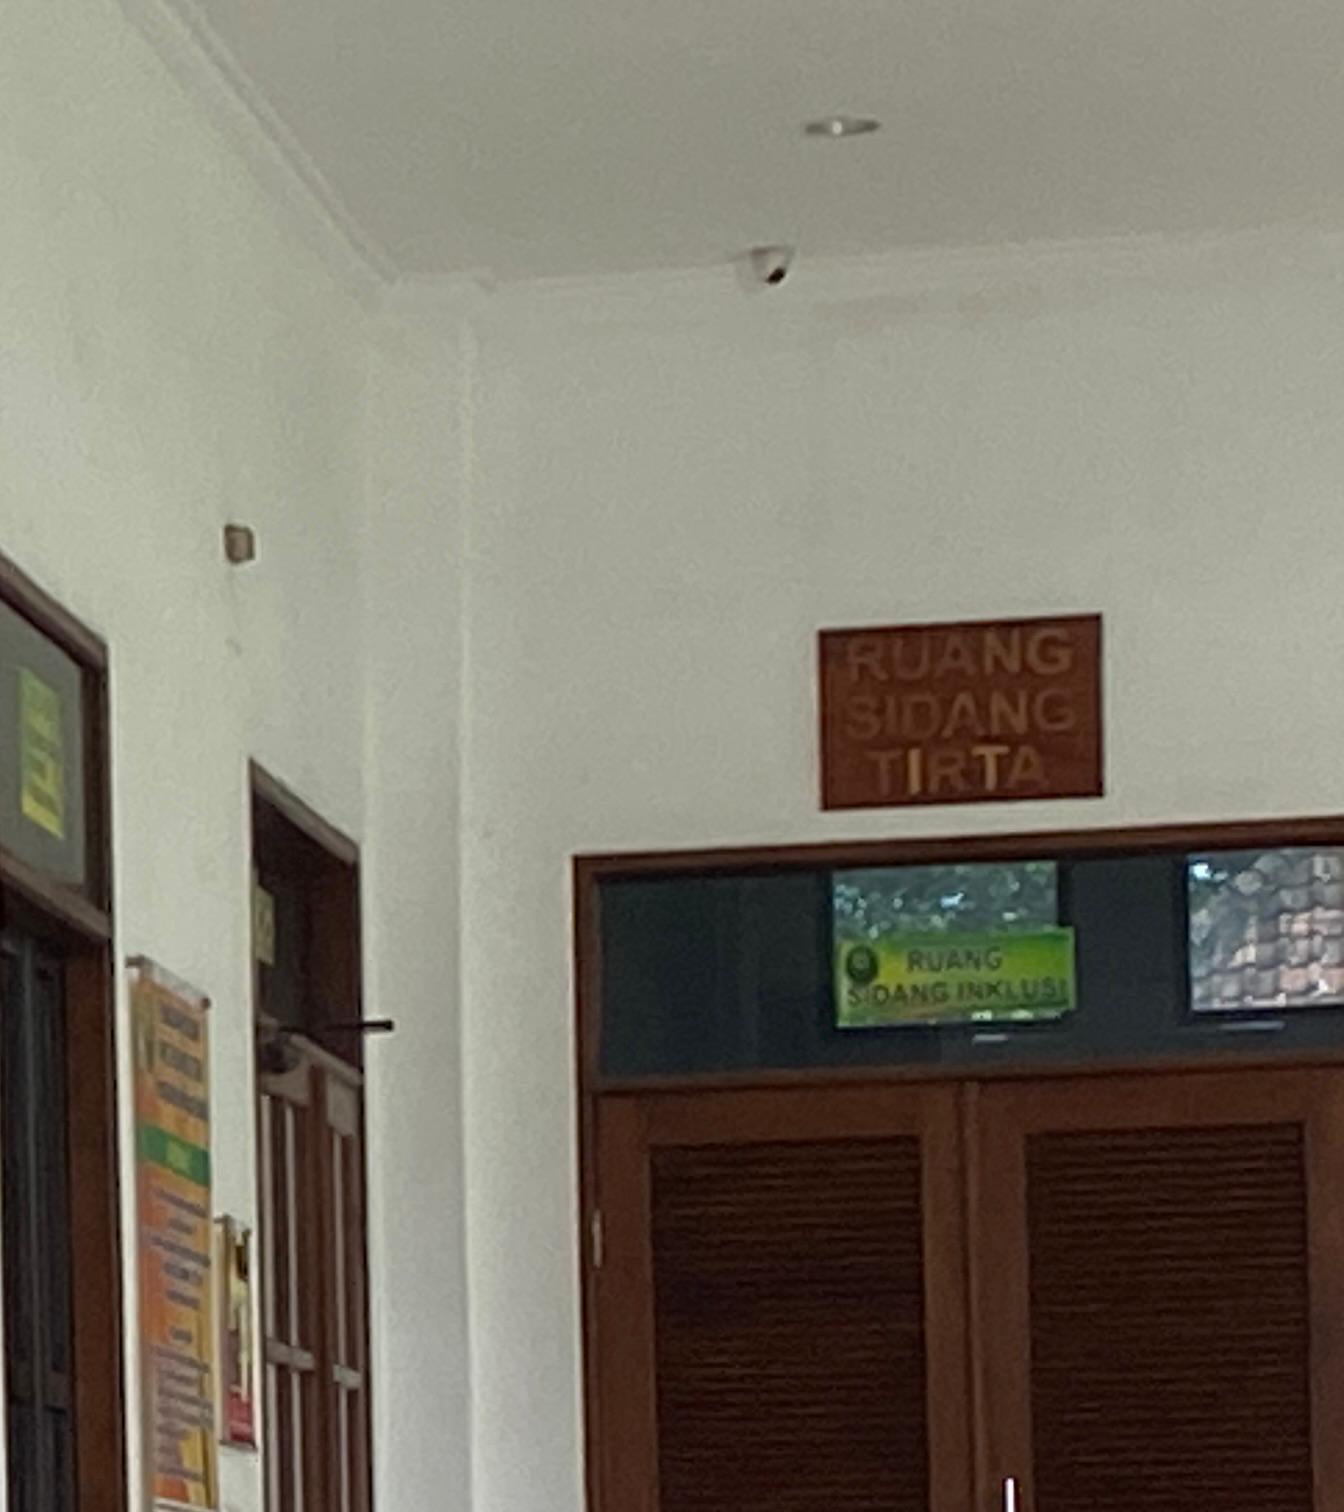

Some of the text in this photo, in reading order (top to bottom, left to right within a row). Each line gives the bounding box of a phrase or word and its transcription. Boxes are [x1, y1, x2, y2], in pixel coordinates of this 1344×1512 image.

[846, 627, 1073, 682] RUANG
[845, 688, 1077, 740] SIDANG
[864, 743, 1050, 797] TIRTA
[905, 946, 1003, 973] RUANG
[847, 981, 950, 1006] SIDANG
